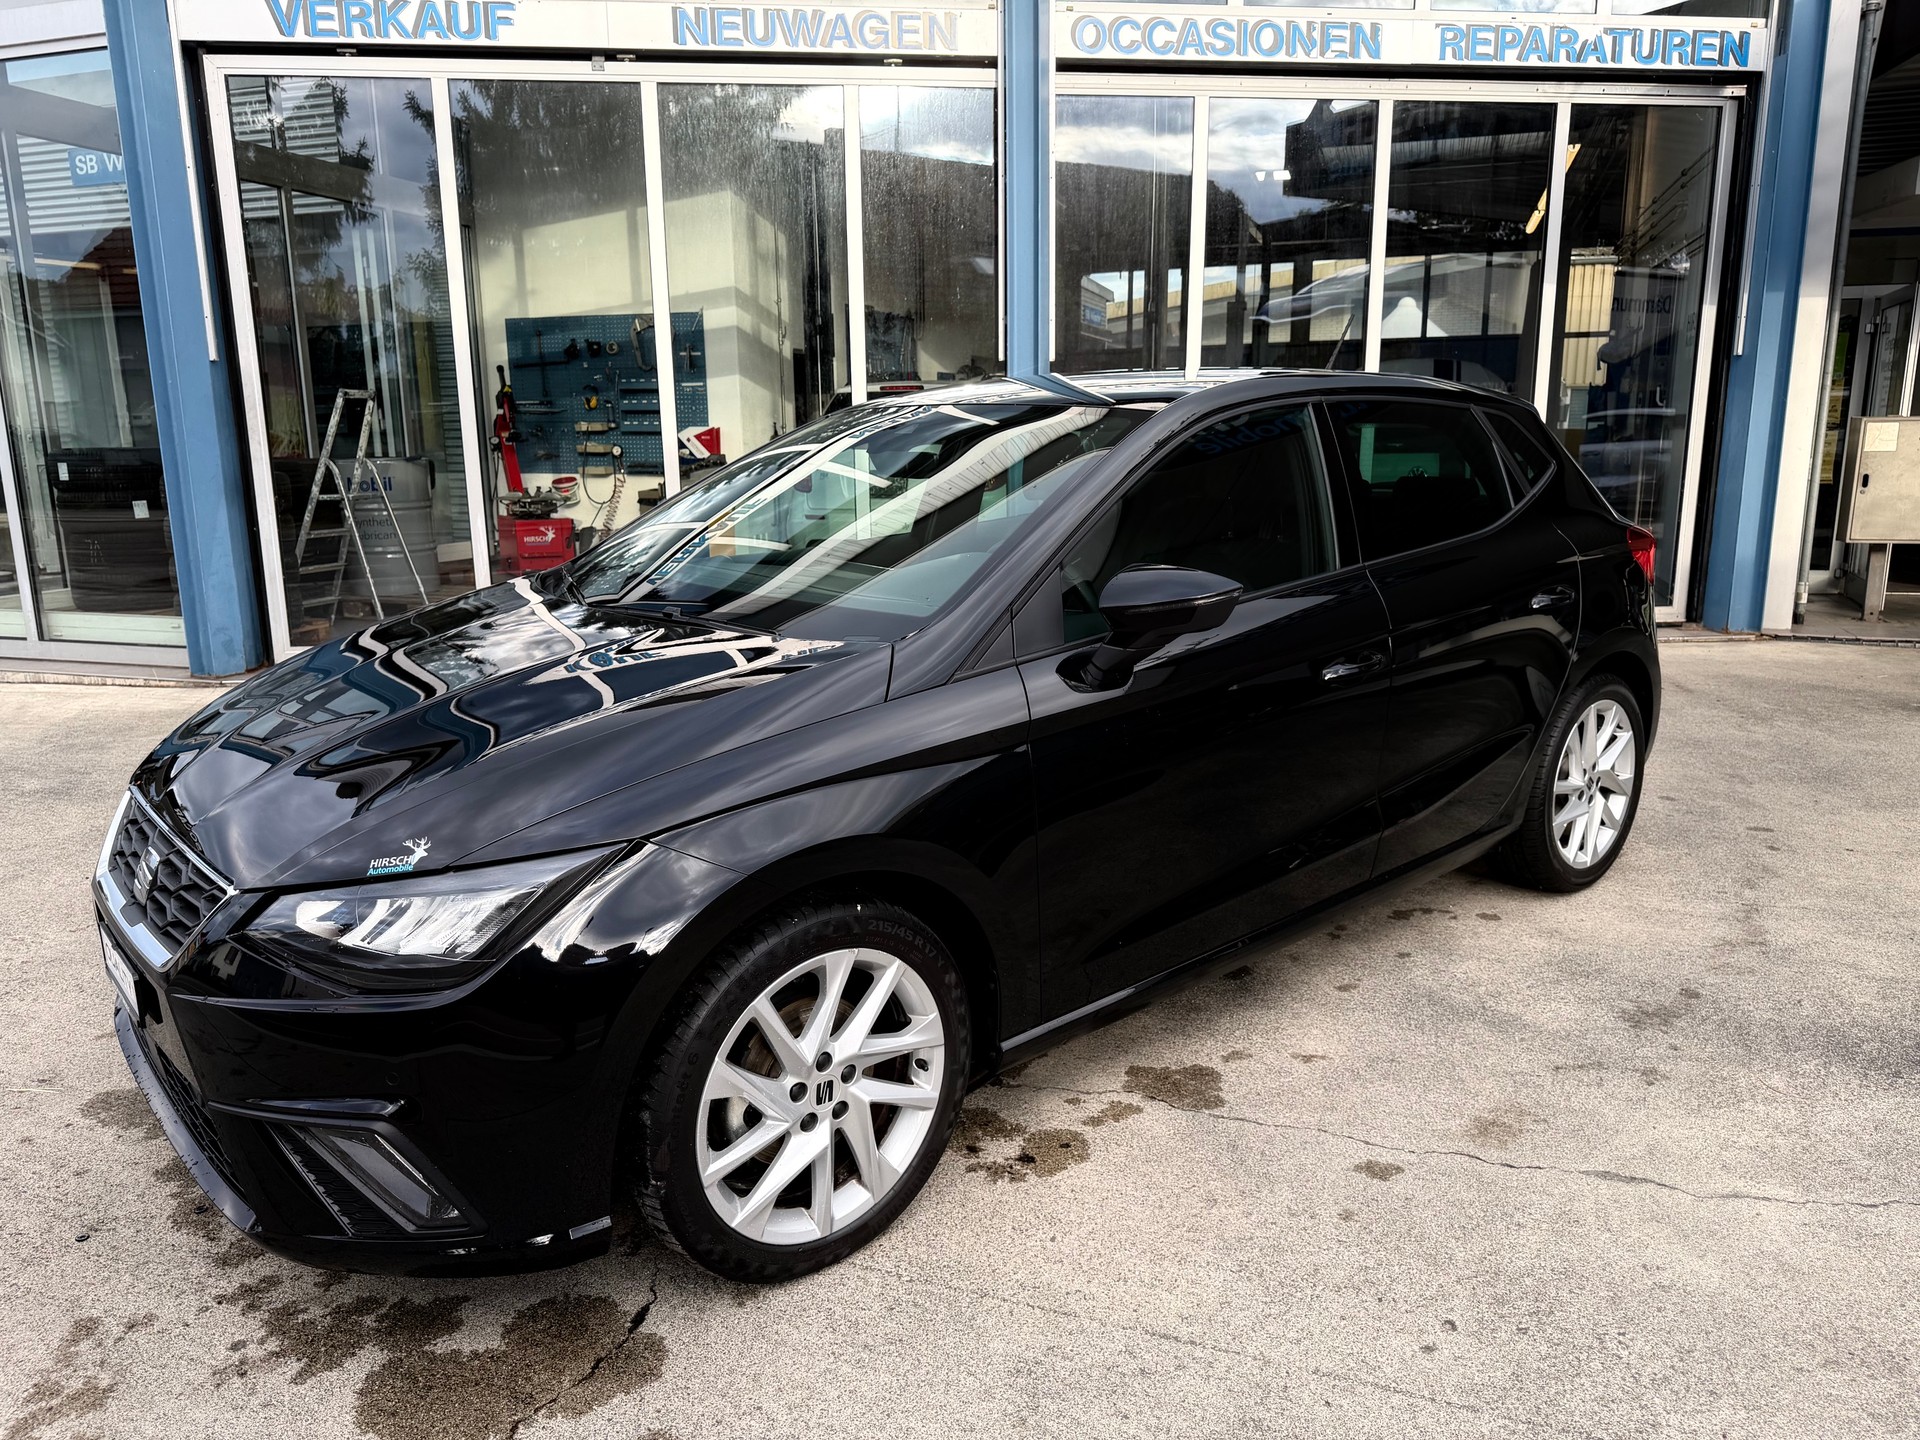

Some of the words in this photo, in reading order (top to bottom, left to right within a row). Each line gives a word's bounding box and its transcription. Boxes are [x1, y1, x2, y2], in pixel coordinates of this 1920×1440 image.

[265, 0, 516, 41] VERKAUF
[672, 6, 958, 51] NEUWAGEN
[1071, 15, 1383, 59] OCCASIONEN
[1436, 23, 1751, 68] REPARATUREN
[75, 154, 98, 175] SB
[524, 535, 550, 543] HIRSCH
[367, 864, 414, 875] Automobile
[369, 855, 413, 868] HIRSCH
[868, 919, 914, 941] 215/45
